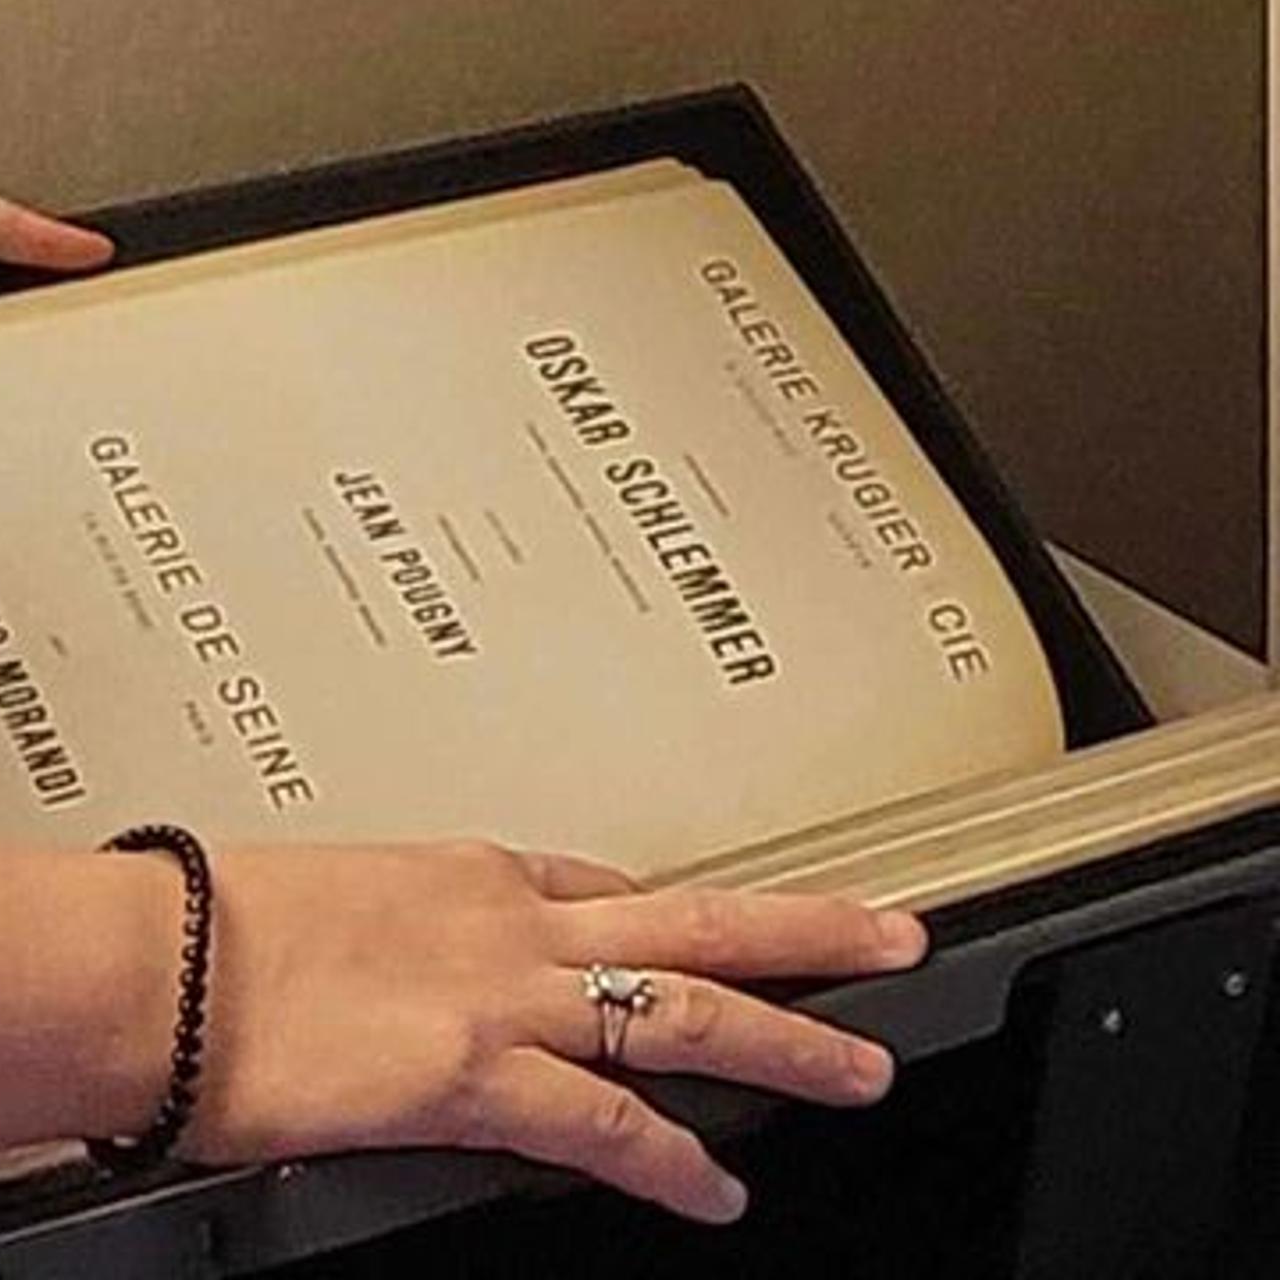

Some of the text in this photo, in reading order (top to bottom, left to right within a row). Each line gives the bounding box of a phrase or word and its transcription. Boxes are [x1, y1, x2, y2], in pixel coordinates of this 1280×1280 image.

[91, 437, 202, 593] GALERIE
[180, 605, 240, 662] DE
[219, 677, 313, 811] SEINE
[335, 473, 406, 541] JEAN
[380, 548, 477, 657] POUGNY
[525, 336, 630, 445] OSKAR
[605, 459, 775, 685] SCHLEMMER
[701, 259, 819, 400] GALERIE
[804, 407, 931, 571] KRUGIER
[929, 603, 988, 682] CIE
